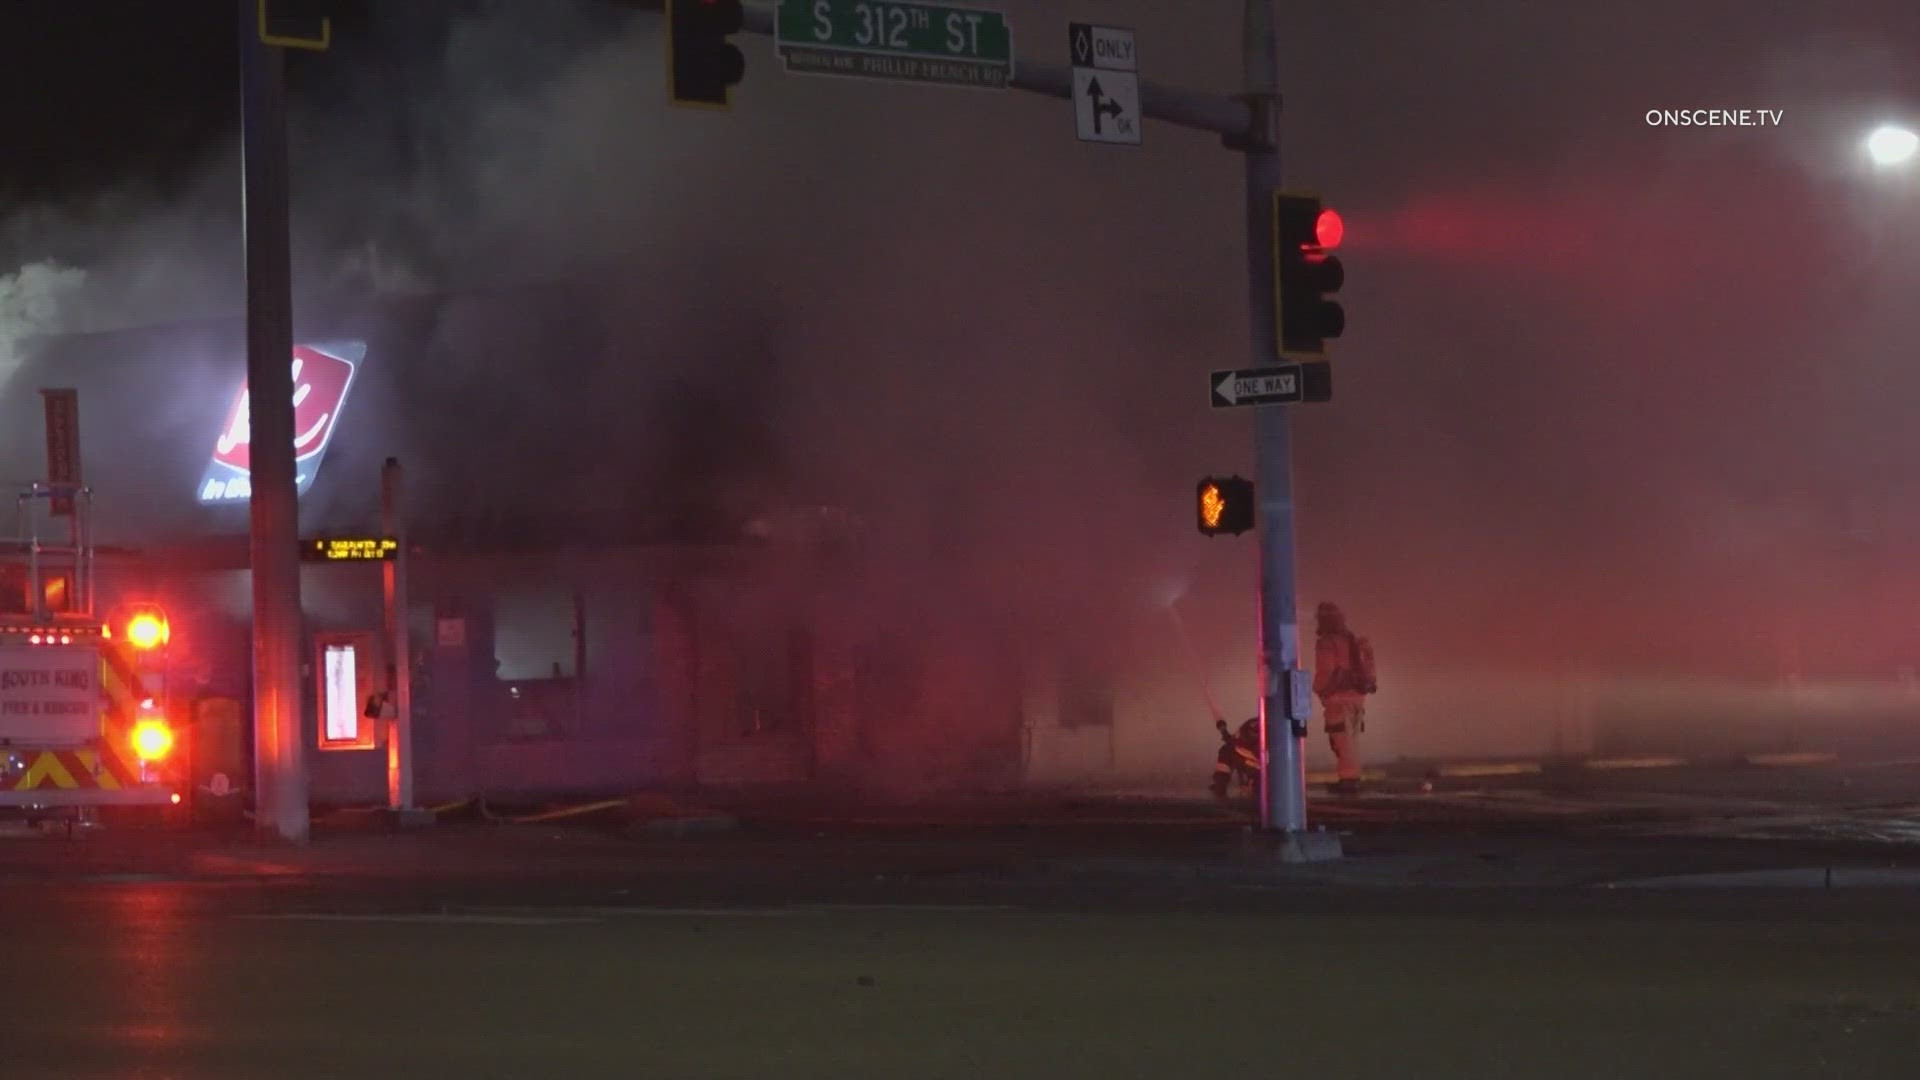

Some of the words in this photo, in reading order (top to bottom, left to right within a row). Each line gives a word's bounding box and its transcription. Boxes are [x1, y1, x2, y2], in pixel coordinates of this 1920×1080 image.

[814, 0, 833, 41] S
[855, 4, 930, 48] 312TH
[946, 12, 983, 56] ST
[1096, 38, 1132, 60] ONLY
[863, 56, 918, 76] PHILLIP
[922, 61, 981, 82] FRENCH
[1118, 117, 1134, 134] OK
[1234, 379, 1259, 396] ONE
[1264, 377, 1291, 393] WAY
[54, 669, 89, 691] KING
